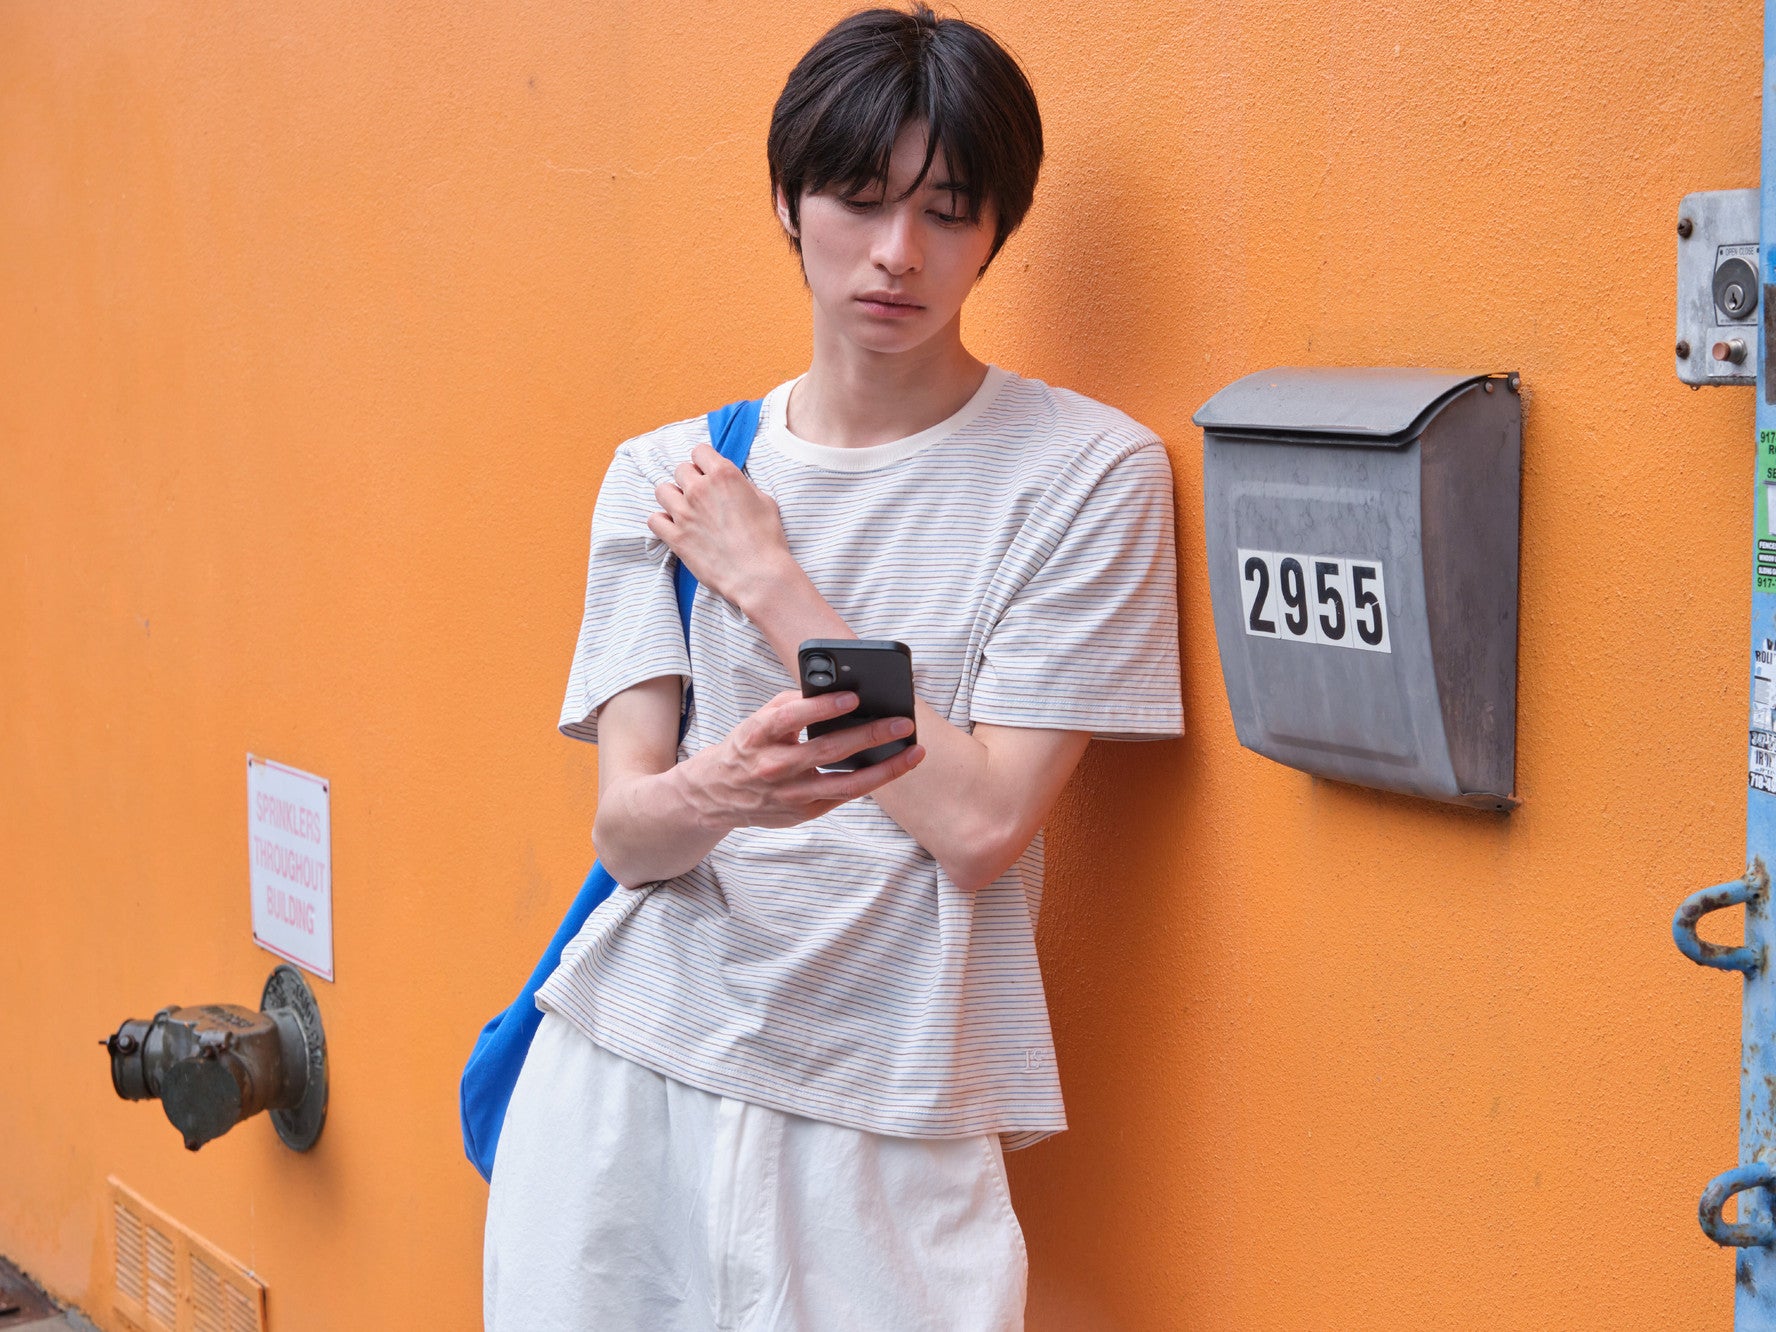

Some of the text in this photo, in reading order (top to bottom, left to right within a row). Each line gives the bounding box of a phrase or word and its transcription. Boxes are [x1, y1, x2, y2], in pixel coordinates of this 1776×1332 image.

[1244, 556, 1383, 646] 2955
[1757, 577, 1776, 588] 917-
[256, 791, 321, 844] SPRINKLERS
[254, 835, 325, 893] THROUGHOUT
[266, 885, 315, 935] BUILDING
